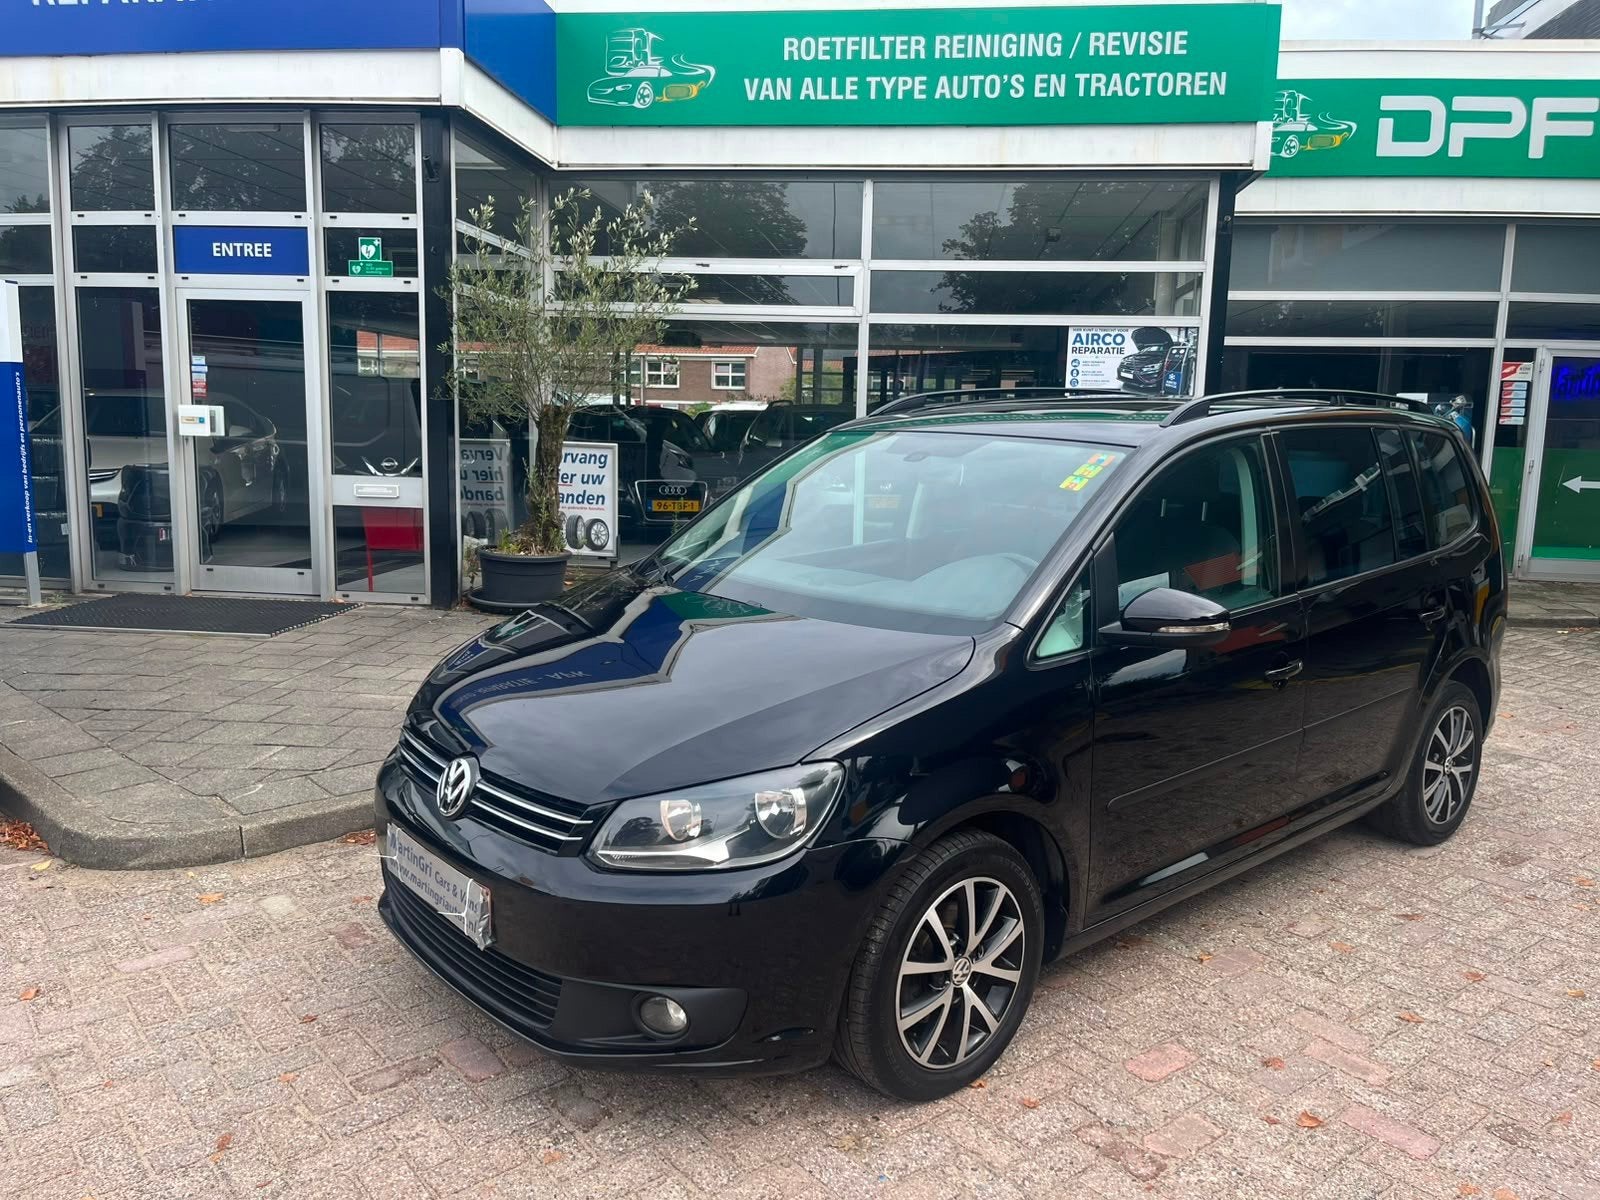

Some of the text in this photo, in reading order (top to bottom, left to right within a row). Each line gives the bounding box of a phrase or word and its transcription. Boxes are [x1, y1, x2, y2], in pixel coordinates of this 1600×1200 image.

[783, 30, 1189, 61] ROETFILTER REINIGING / REVISIE
[743, 71, 1227, 101] VAN ALLE TYPE AUTO'S EN TRACTOREN
[1376, 95, 1600, 159] DPF
[212, 242, 273, 257] ENTREE
[1072, 332, 1126, 346] AIRCO
[1071, 346, 1126, 355] REPARATIE
[20, 432, 25, 443] en
[20, 443, 28, 474] bedrijfs
[563, 452, 608, 469] rvang
[580, 473, 605, 485] uw
[558, 489, 606, 506] anden
[434, 871, 451, 892] Cars
[452, 884, 458, 897] &
